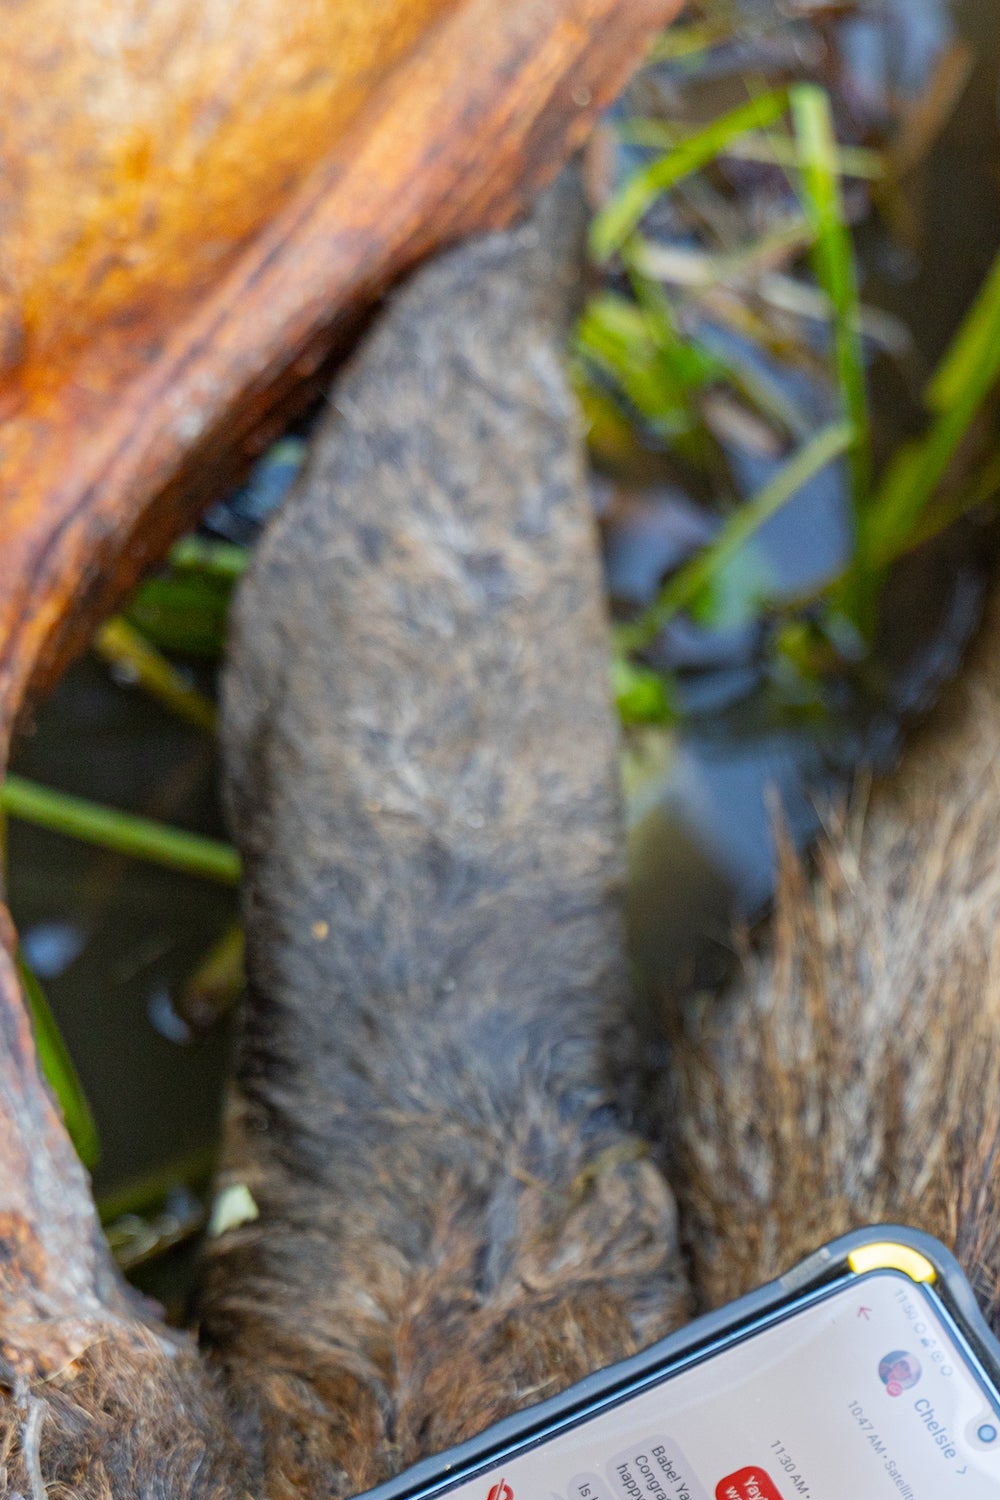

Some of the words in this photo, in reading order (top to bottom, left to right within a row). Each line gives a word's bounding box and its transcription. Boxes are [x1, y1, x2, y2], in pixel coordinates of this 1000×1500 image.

[847, 1400, 874, 1431] 10:47
[866, 1434, 887, 1455] AM
[913, 1398, 957, 1459] Chelsie
[577, 1482, 592, 1498] Is
[651, 1445, 682, 1484] Babe!
[770, 1439, 797, 1473] 11:30
[789, 1474, 810, 1495] AM
